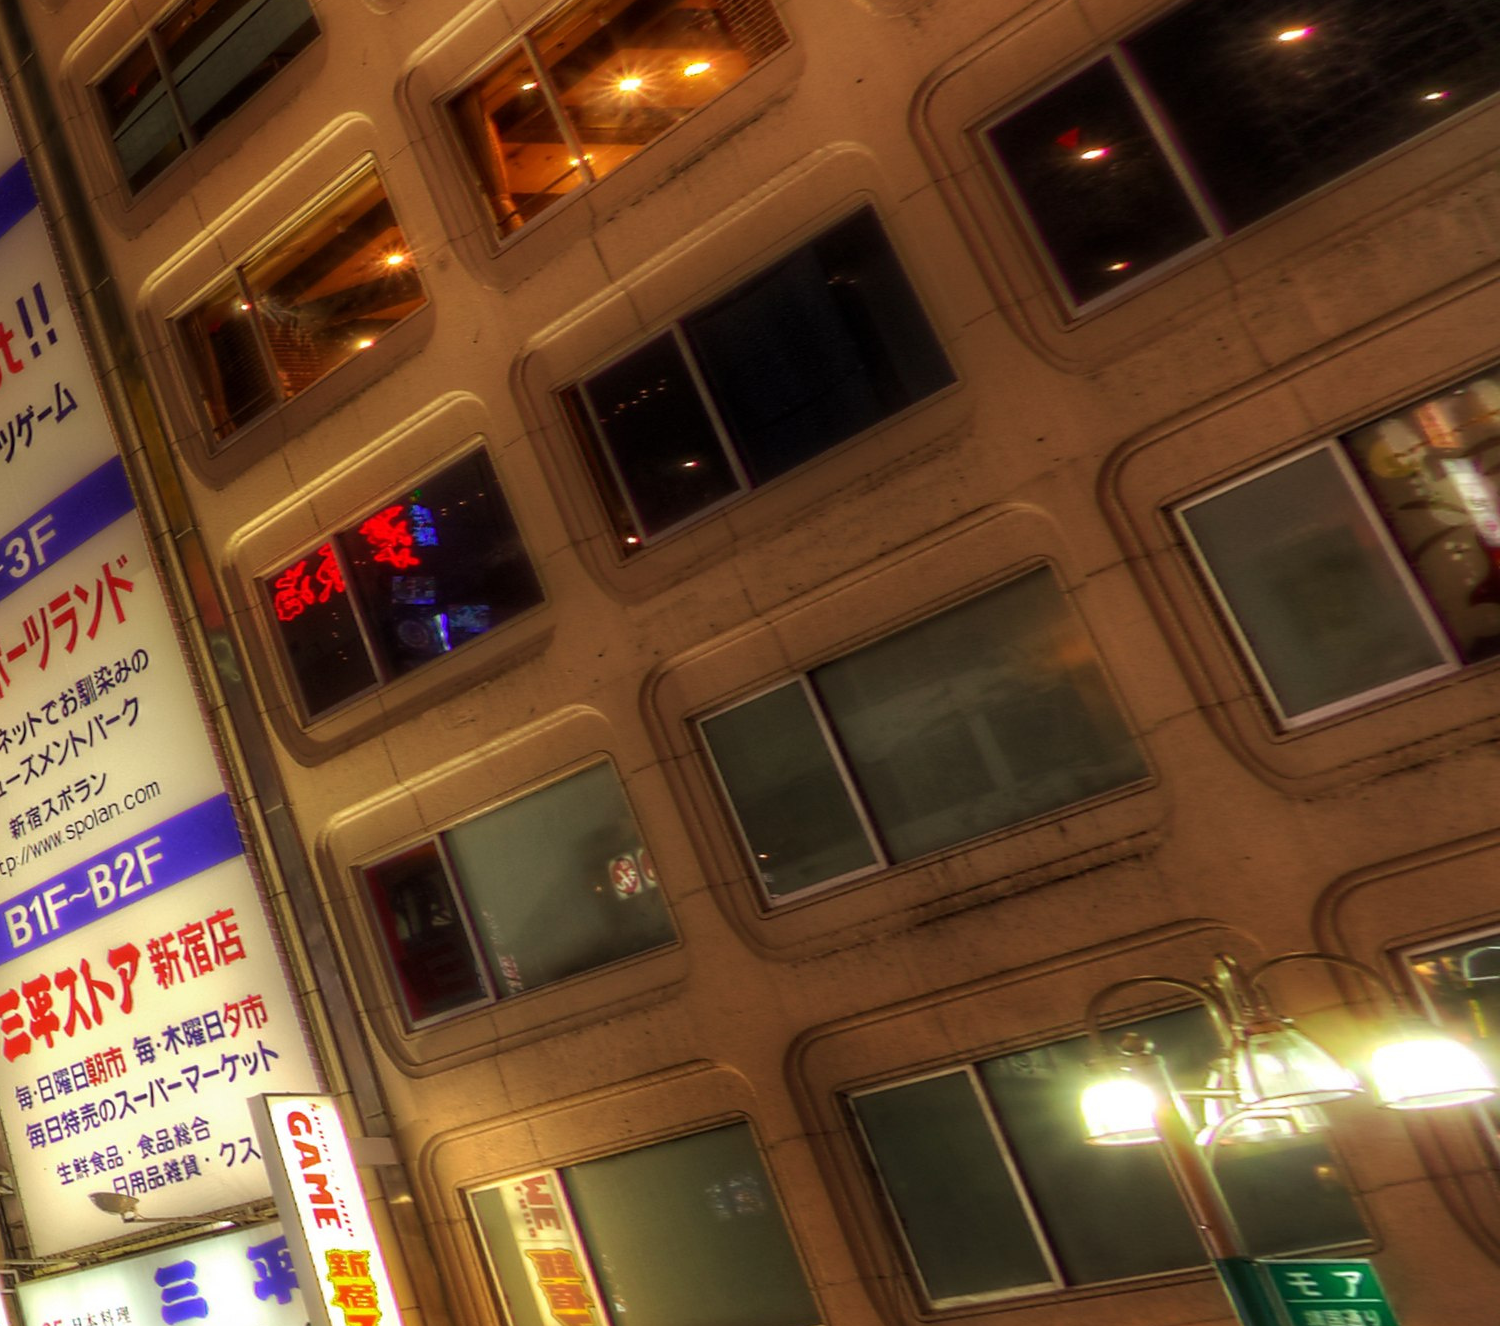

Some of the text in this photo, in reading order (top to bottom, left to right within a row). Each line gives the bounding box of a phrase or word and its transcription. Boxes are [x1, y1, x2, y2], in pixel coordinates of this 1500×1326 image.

[145, 907, 248, 989] 新宿店
[24, 1040, 281, 1150] 毎日特売のスーパーマーケット
[54, 1116, 213, 1185] 生鮮食品・食品総合
[285, 1109, 342, 1231] GAME
[1286, 1271, 1362, 1299] モア
